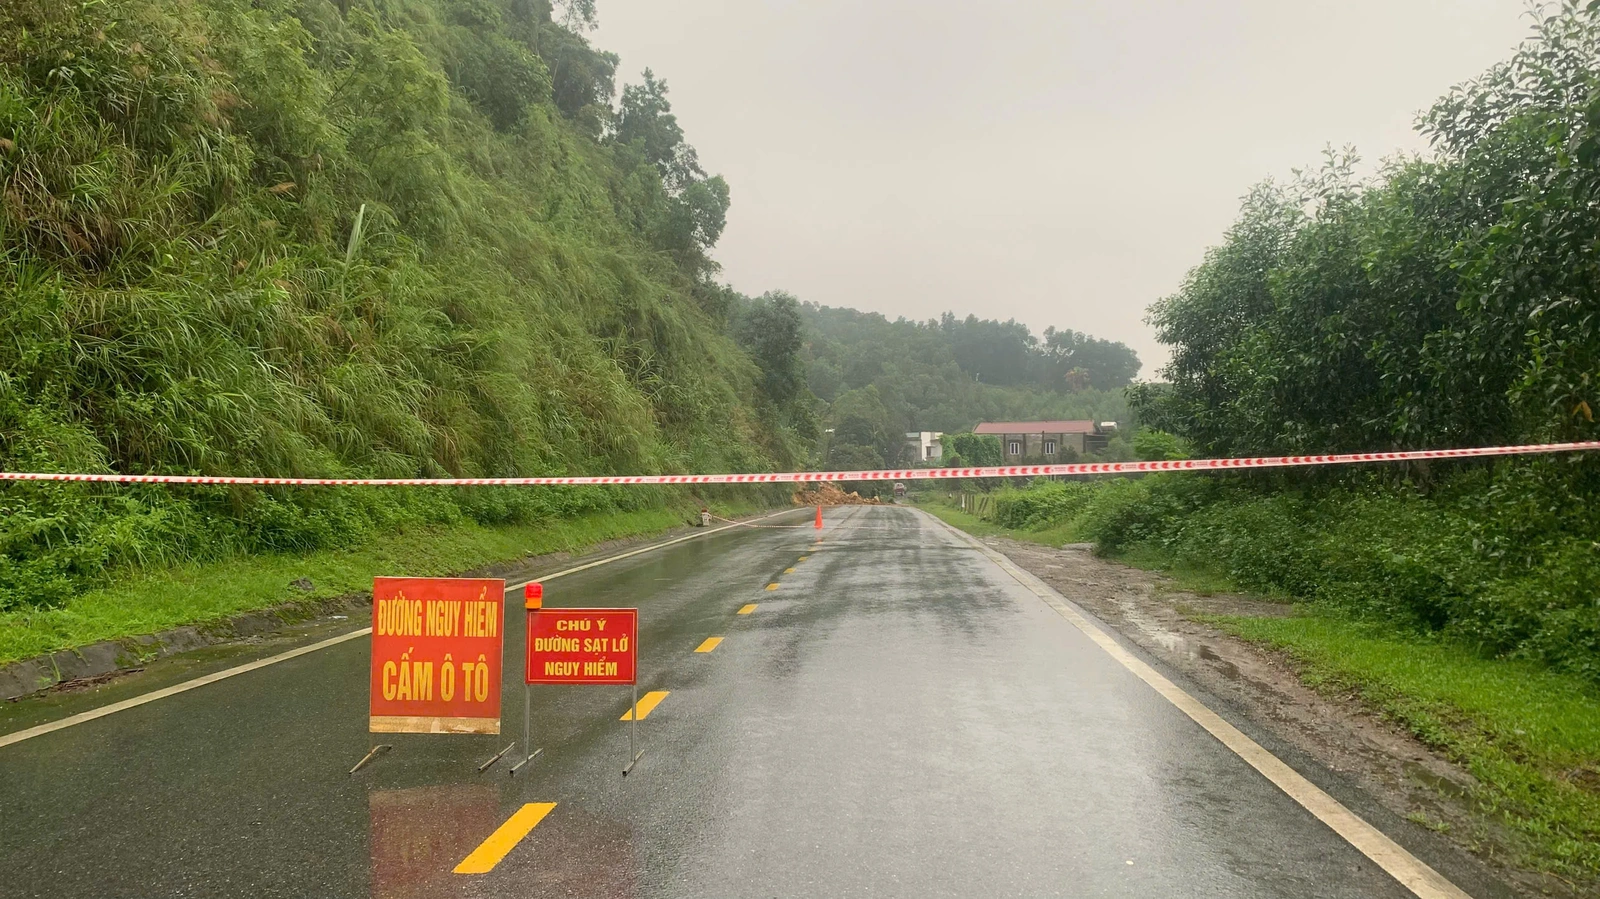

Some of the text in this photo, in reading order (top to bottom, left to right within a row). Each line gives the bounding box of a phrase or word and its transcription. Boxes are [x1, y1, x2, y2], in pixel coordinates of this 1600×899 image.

[378, 586, 498, 638] ĐƯỜNG NGUY HIỂM
[556, 618, 607, 631] CHÚ Ý
[535, 633, 629, 656] ĐƯỜNG SẠT LỞ
[383, 647, 489, 703] CẤM Ô TÔ
[545, 656, 618, 676] NGUY HIỂM
